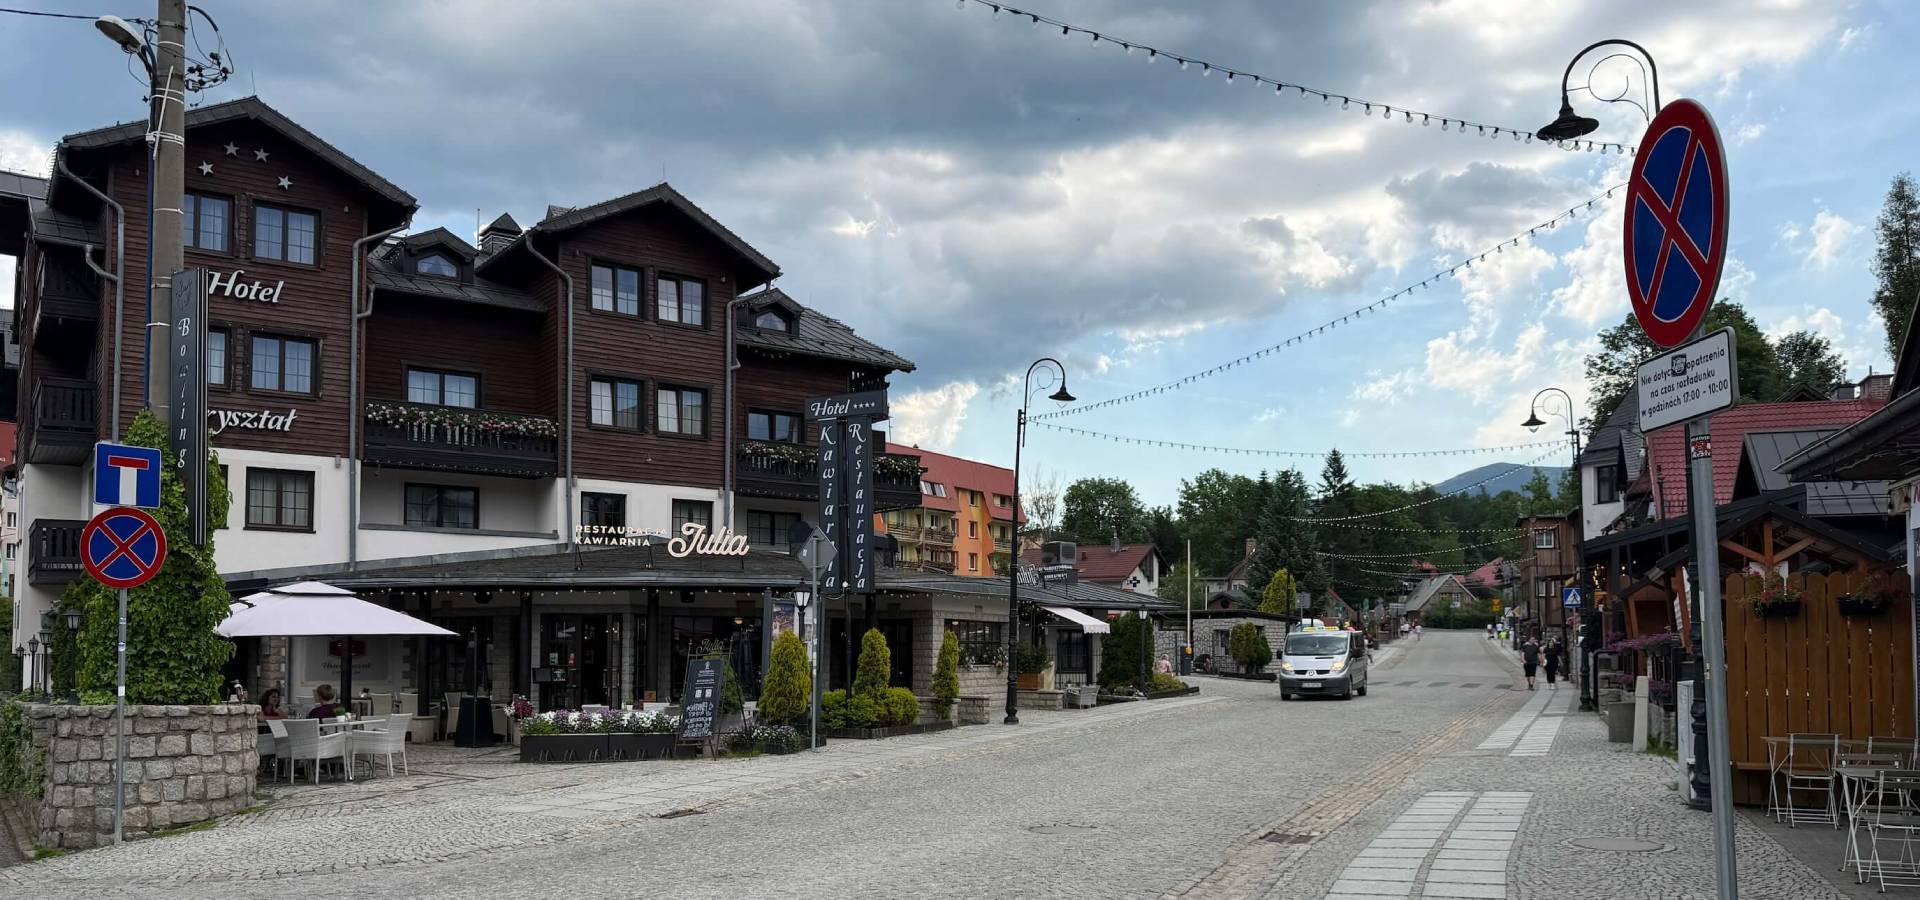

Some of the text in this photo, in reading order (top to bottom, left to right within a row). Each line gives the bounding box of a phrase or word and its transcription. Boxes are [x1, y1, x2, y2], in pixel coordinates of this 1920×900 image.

[208, 270, 284, 303] Hotel
[1641, 375, 1652, 386] Nie
[1654, 368, 1672, 382] dotyc
[1686, 346, 1725, 370] opatrzenia
[178, 317, 191, 468] Bowling
[810, 398, 850, 416] Hotel
[1648, 397, 1682, 417] godzinach
[1708, 379, 1729, 395] 10:00
[1650, 389, 1659, 399] na
[1661, 383, 1675, 395] czas
[207, 408, 298, 435] ryształ
[848, 423, 867, 589] Restauracja
[575, 524, 667, 536] RESTAURACJA
[575, 536, 651, 547] KAWIARNIA
[667, 522, 750, 558] Julia
